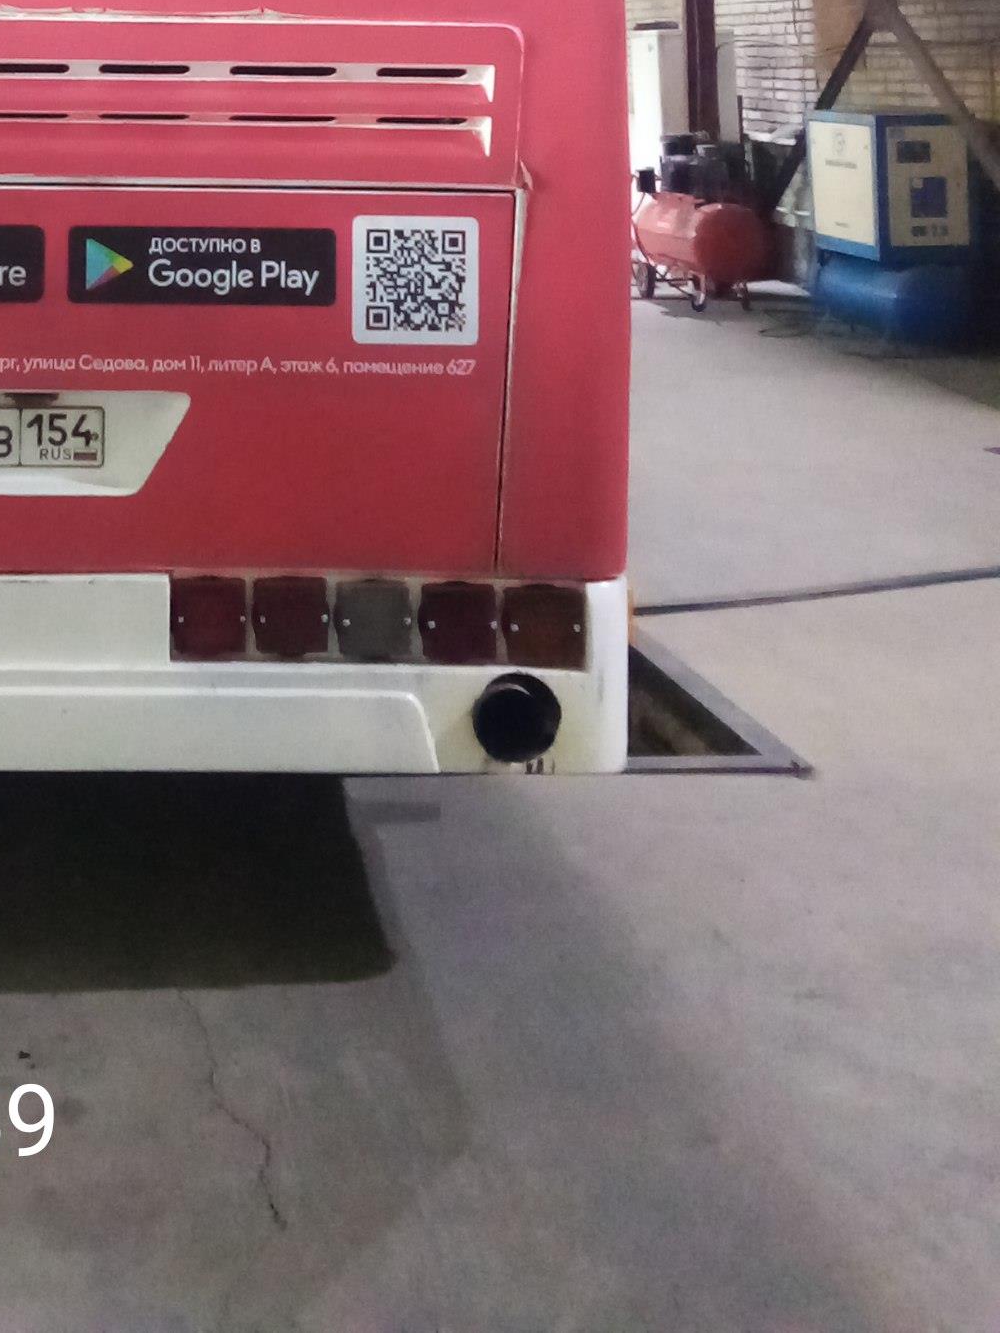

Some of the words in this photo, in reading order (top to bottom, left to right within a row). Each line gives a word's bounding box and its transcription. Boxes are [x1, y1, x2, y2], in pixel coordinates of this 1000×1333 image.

[149, 237, 246, 254] ДОСТУПНО
[250, 238, 261, 253] В
[148, 259, 253, 295] Google
[261, 261, 320, 296] Play
[23, 357, 75, 373] улица
[152, 358, 186, 373] дом
[208, 359, 257, 375] литер
[280, 359, 322, 373] этаж
[326, 357, 339, 374] 6,
[344, 360, 443, 376] помещение
[446, 359, 476, 375] 627
[27, 414, 91, 447] 154
[39, 448, 71, 461] RUS
